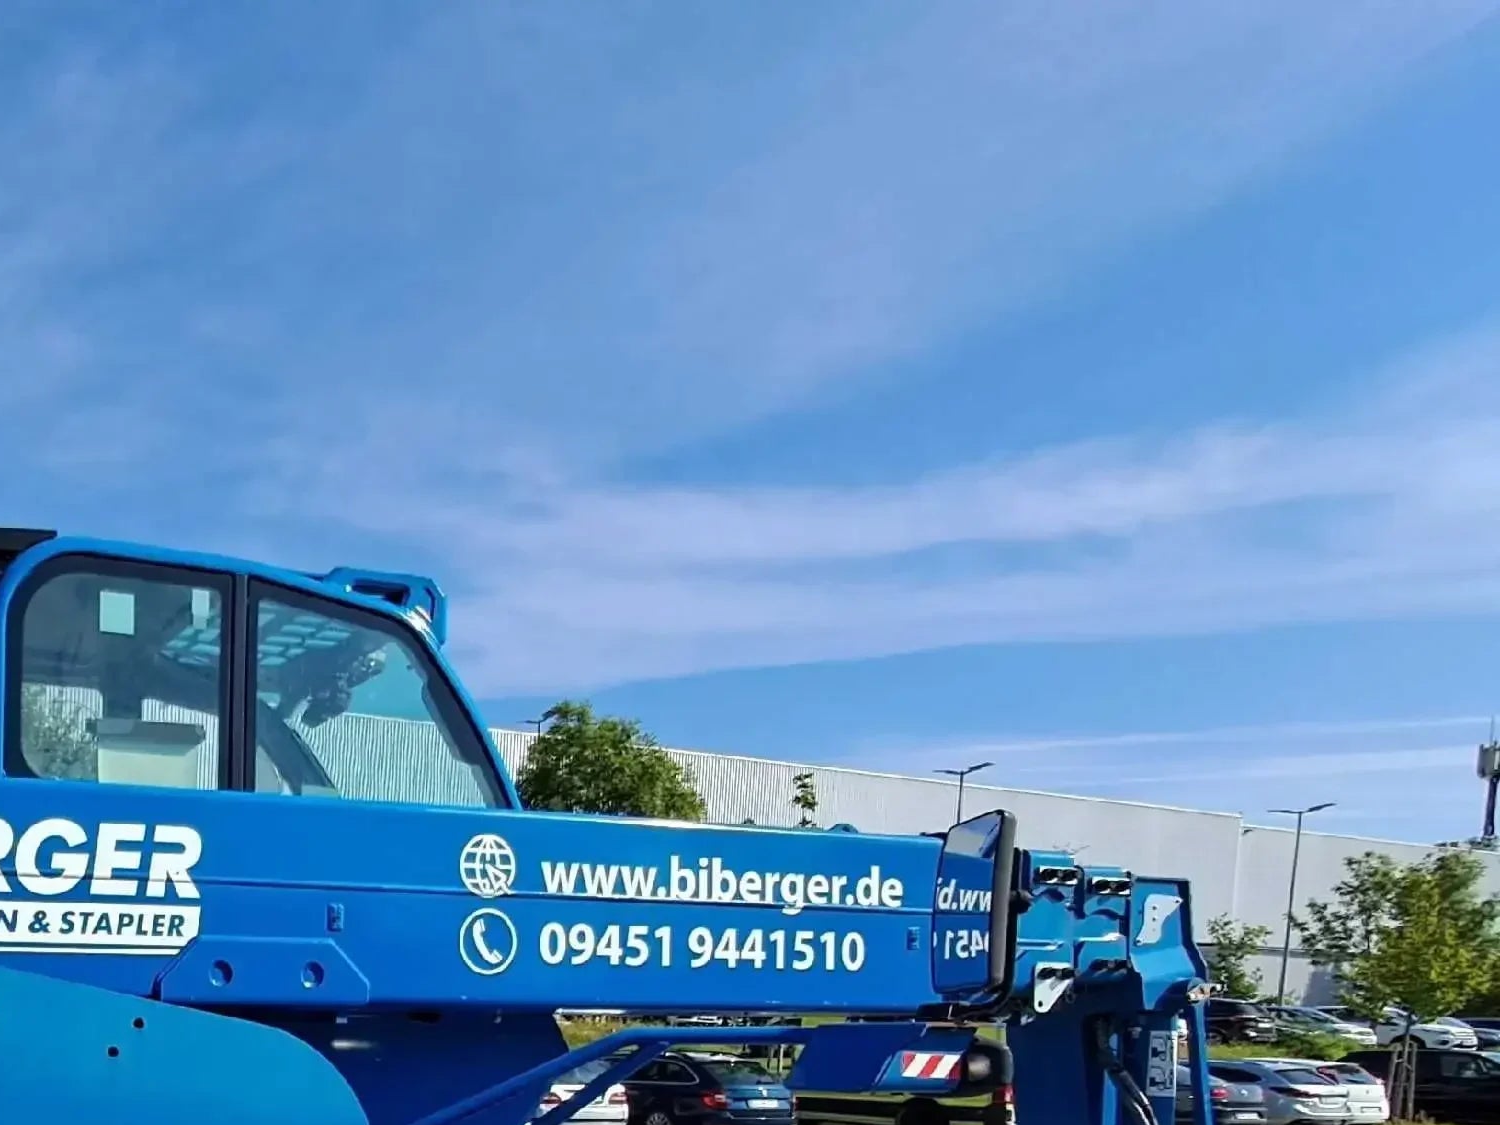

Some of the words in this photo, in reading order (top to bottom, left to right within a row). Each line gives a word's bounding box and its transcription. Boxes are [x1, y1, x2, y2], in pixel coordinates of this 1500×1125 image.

[542, 855, 903, 915] www.biberger.de
[27, 909, 51, 934] &
[59, 910, 186, 938] STAPLER
[539, 923, 671, 966] 09451
[688, 927, 865, 972] 9441510
